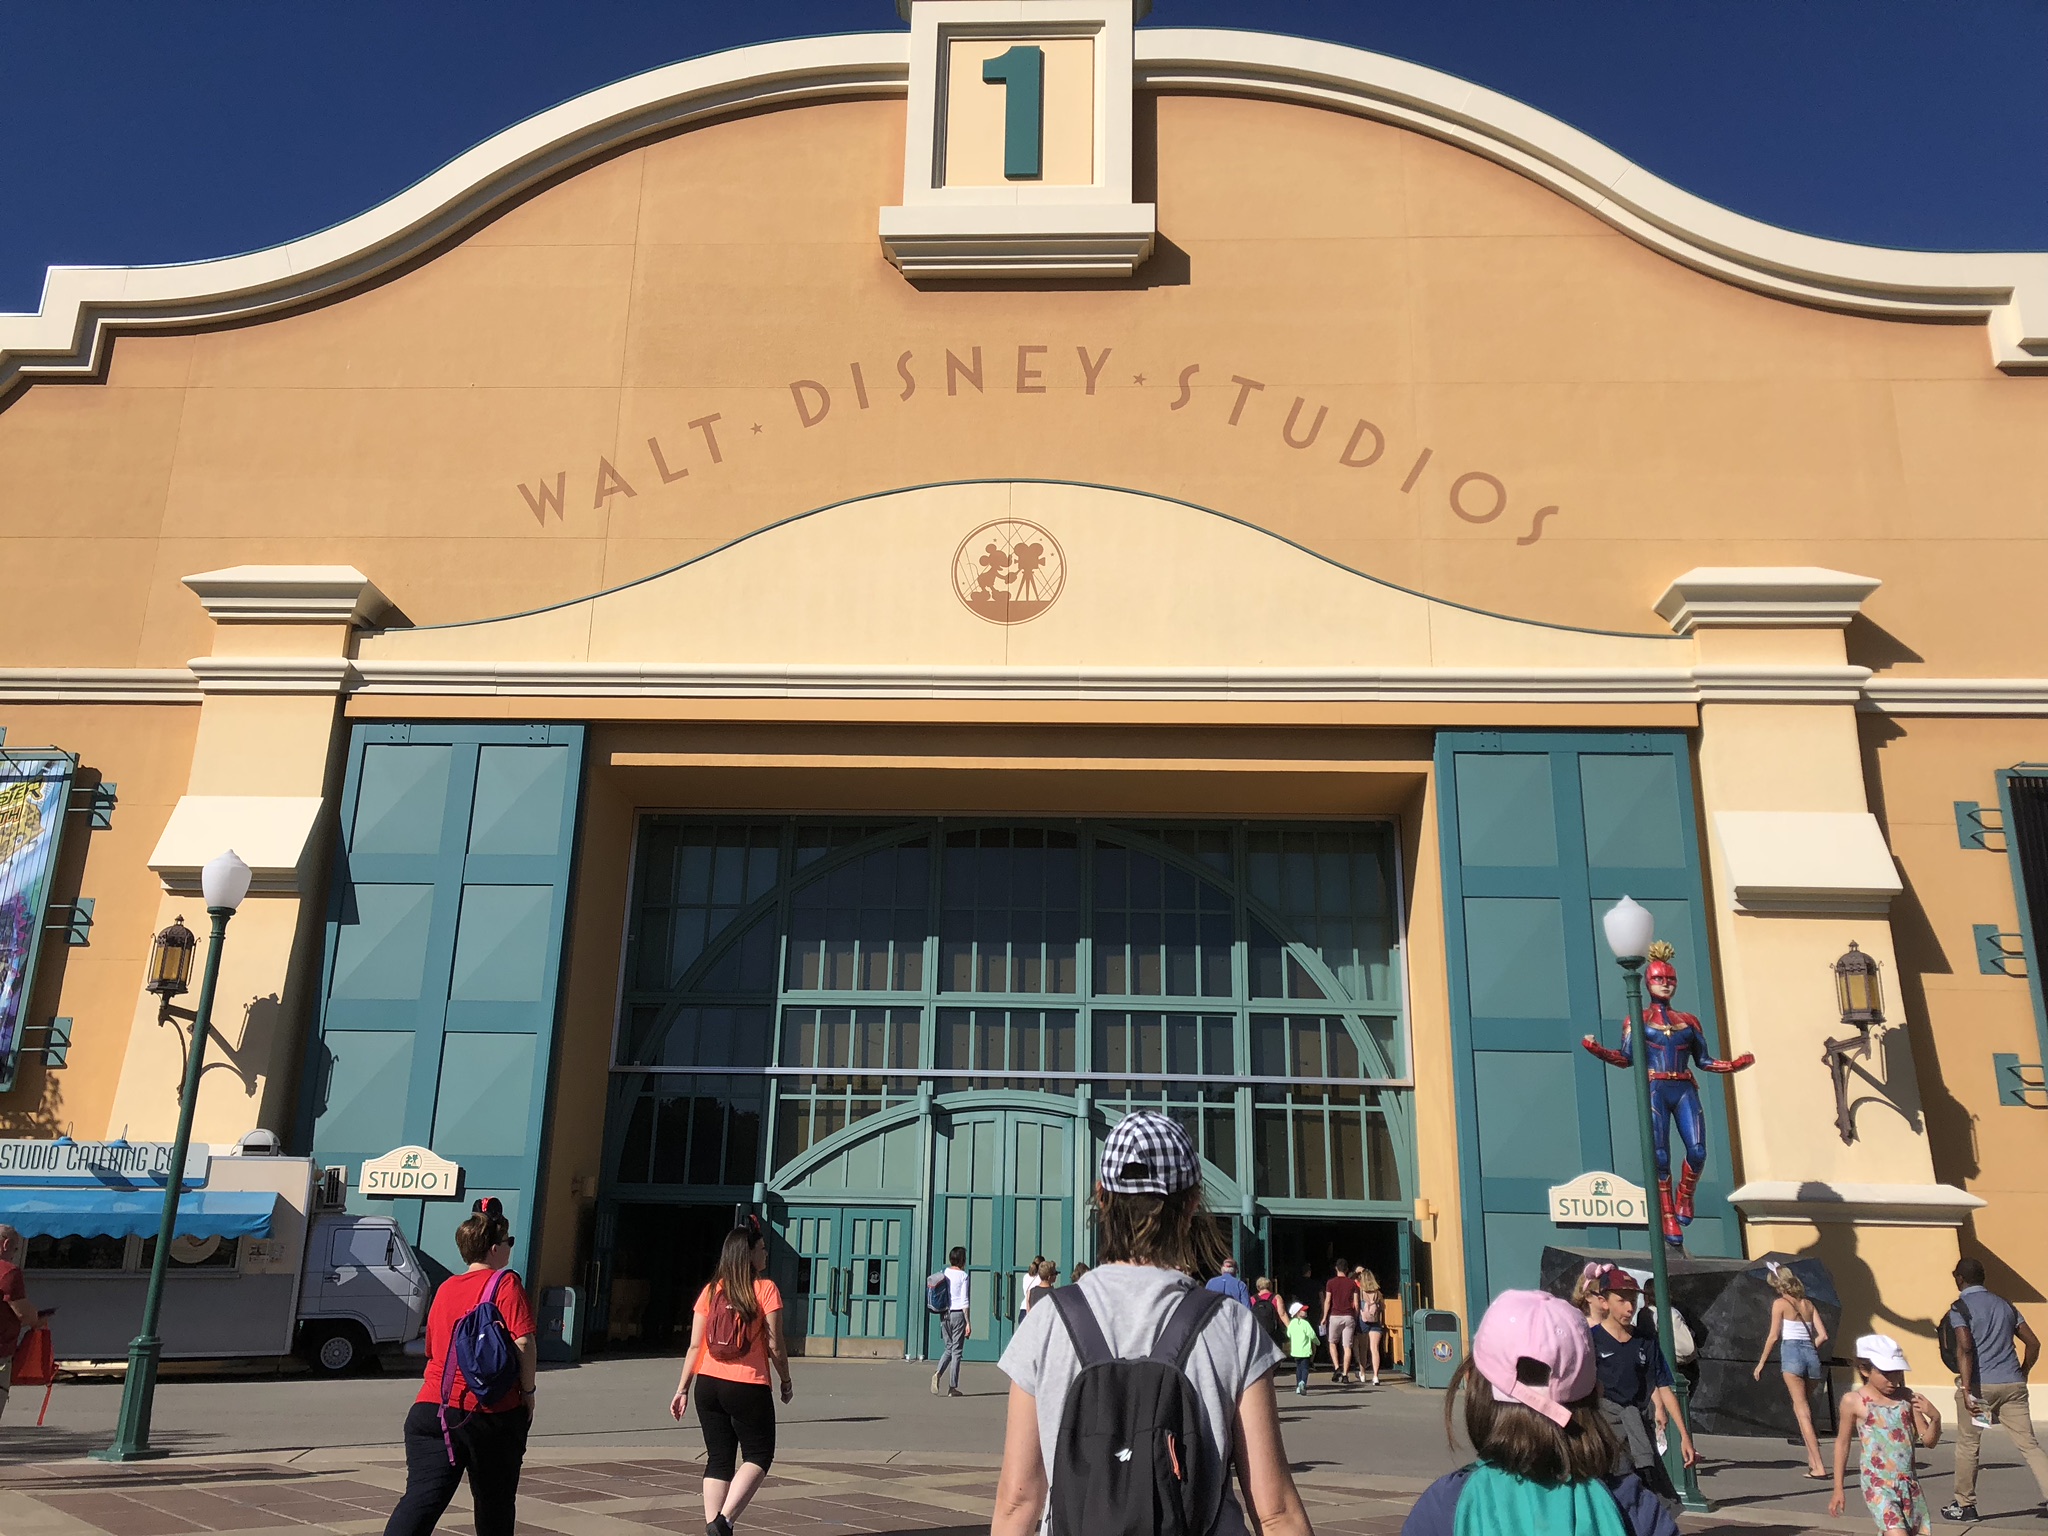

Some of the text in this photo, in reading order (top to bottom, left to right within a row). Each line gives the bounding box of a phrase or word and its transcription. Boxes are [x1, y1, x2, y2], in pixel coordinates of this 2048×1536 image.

[981, 45, 1044, 180] 1
[516, 345, 1560, 546] WALT DISNEY STUDIOS
[0, 1144, 59, 1171] STUDIO
[66, 1145, 149, 1172] CATERING
[367, 1171, 449, 1189] STUDIO 1
[1559, 1198, 1647, 1217] STUDIO 1
